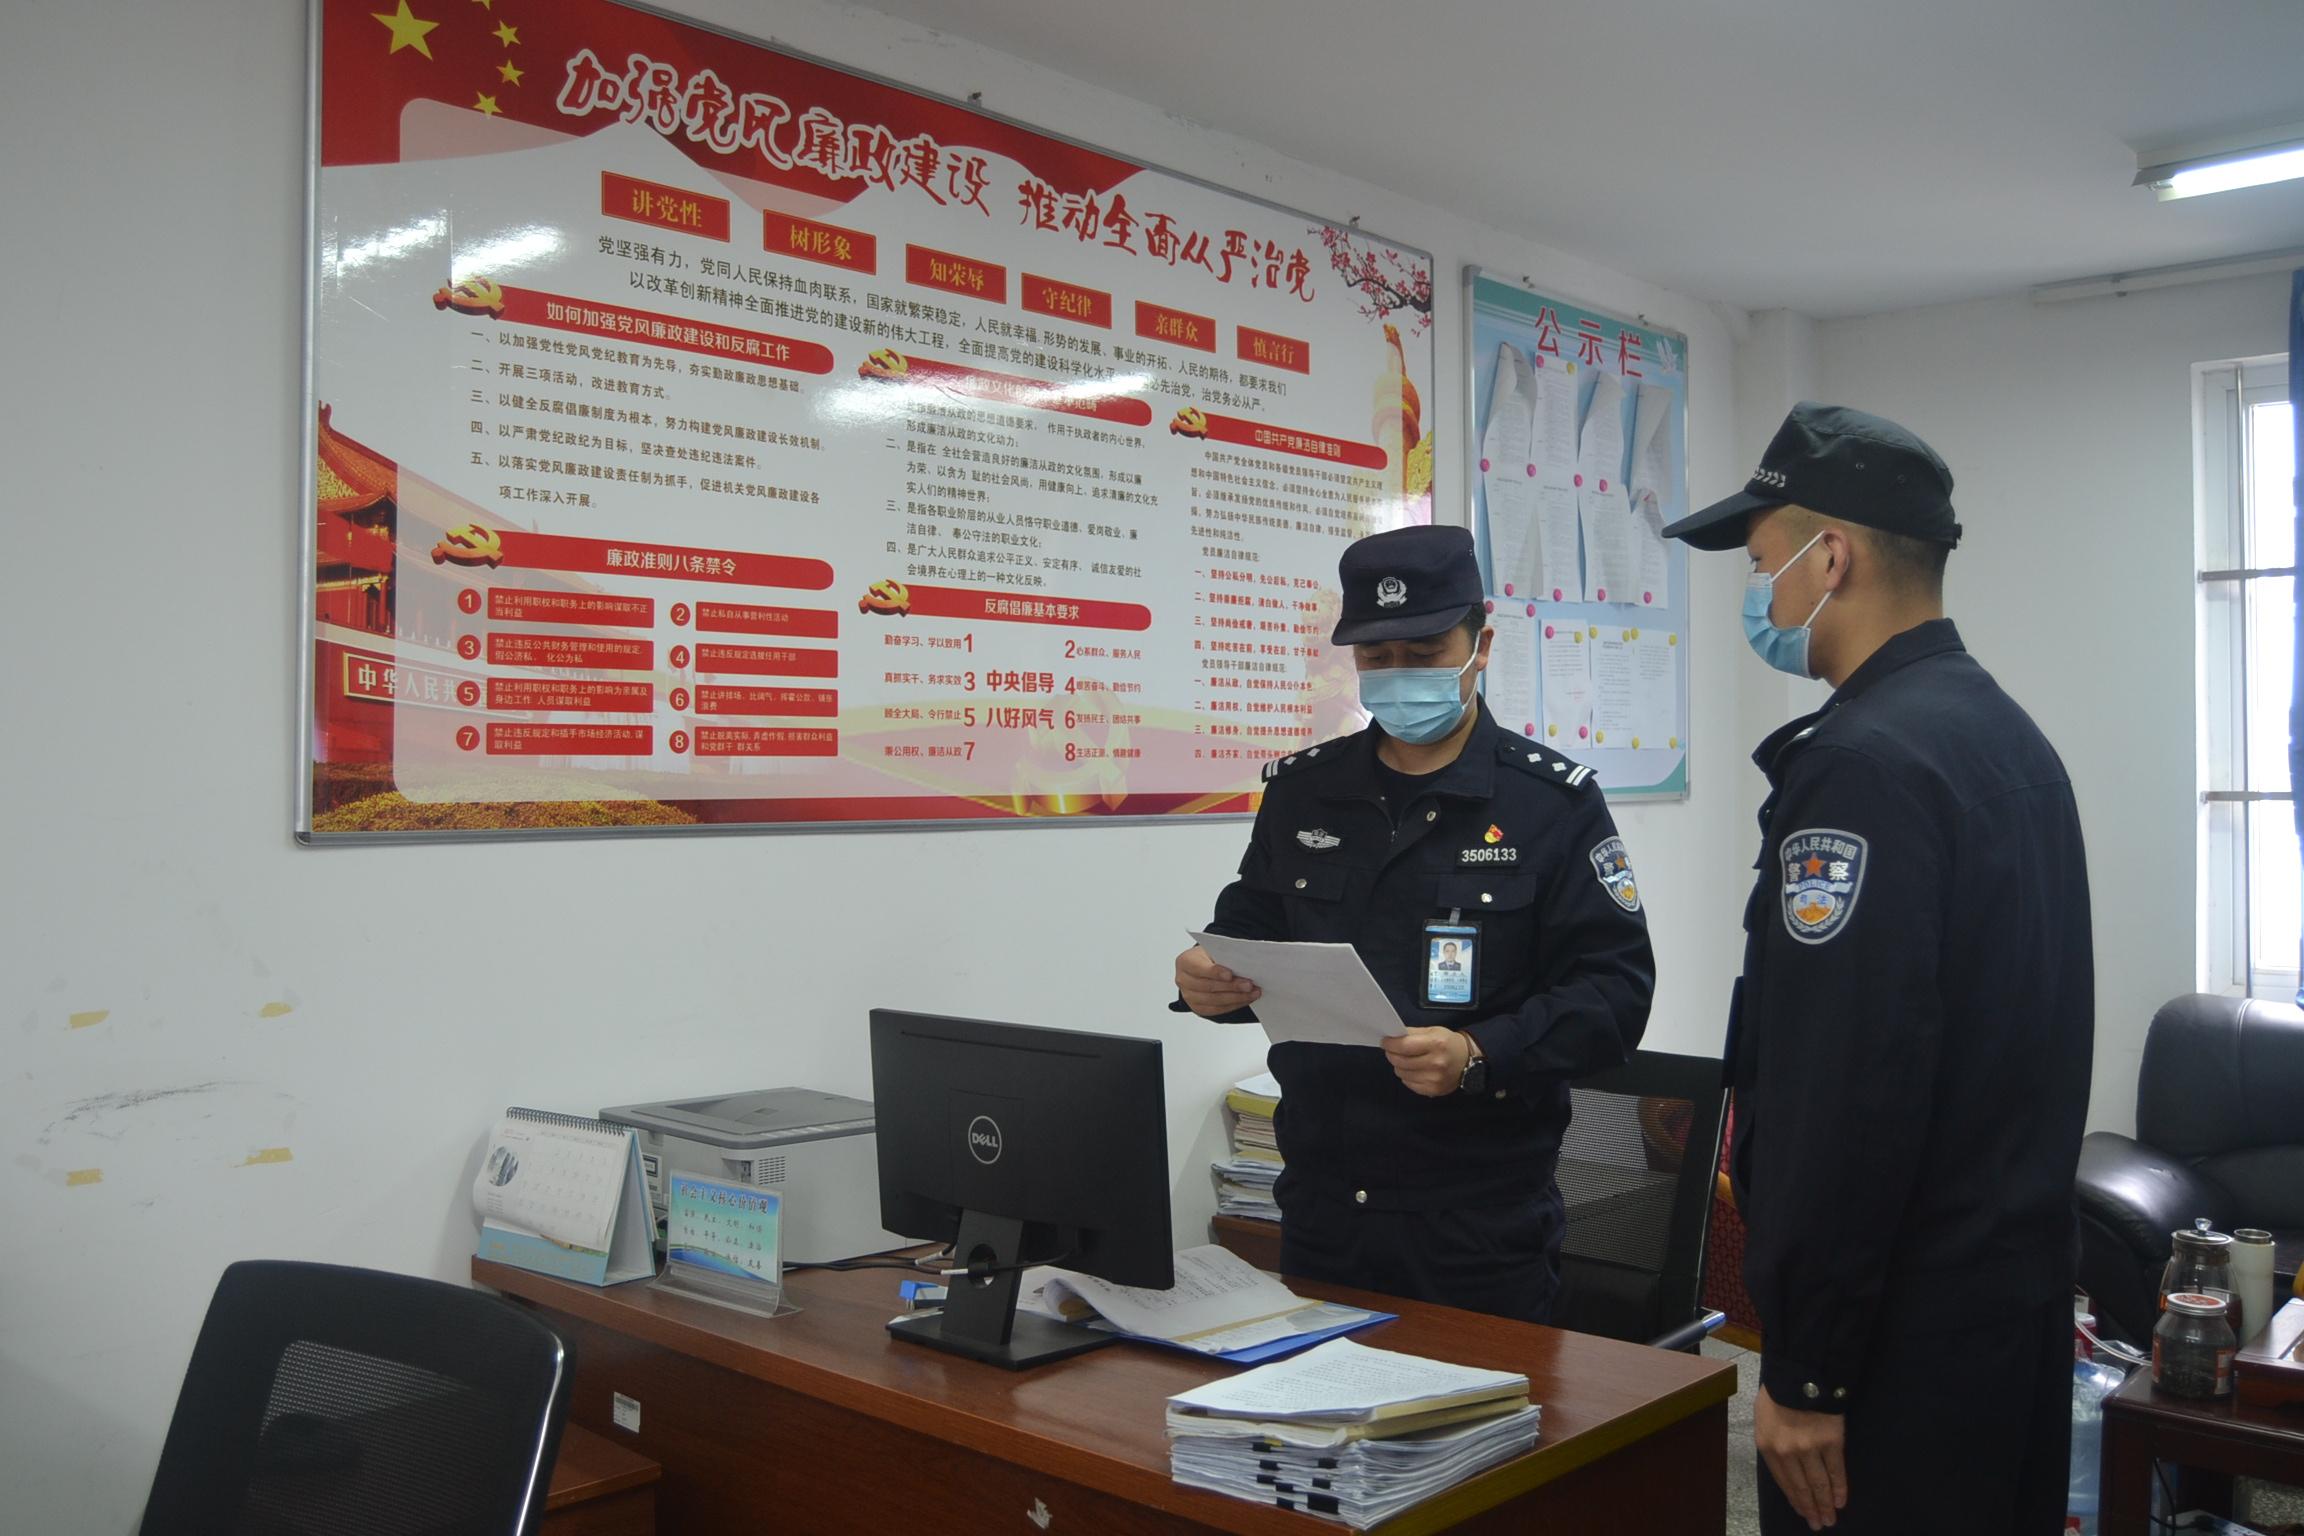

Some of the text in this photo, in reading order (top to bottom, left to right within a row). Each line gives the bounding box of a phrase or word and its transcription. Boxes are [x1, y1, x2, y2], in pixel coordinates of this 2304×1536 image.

[557, 49, 1316, 302] 加强党风廉政建设 推动全面从严治党
[632, 188, 703, 228] 讲党性
[790, 224, 852, 261] 树形象
[929, 256, 985, 292] 知荣辱
[1042, 286, 1093, 318] 守纪律
[546, 301, 790, 362] 如何加强党风廉政建设和反腐工作
[1155, 314, 1199, 343] 亲群众
[1253, 336, 1295, 365] 慎言行
[1535, 305, 1642, 378] 公示栏
[471, 359, 670, 400] 二、开展三项活动，改进教育方式。
[499, 485, 598, 508] 项工作深入开展。
[606, 548, 737, 576] 廉政准则八条禁令
[984, 599, 1080, 620] 反腐倡廉基本要求
[963, 633, 973, 653] 1
[1065, 640, 1076, 659] 2
[964, 671, 976, 691] 3
[986, 669, 1055, 693] 中央倡导
[1065, 676, 1076, 695] 4
[963, 707, 976, 727] 5
[986, 707, 1055, 730] 八好风气
[1065, 710, 1076, 729] 6
[963, 741, 976, 761] 7
[1065, 743, 1076, 761] 8
[1461, 848, 1518, 863] 3506133
[1785, 836, 1858, 861] 中华人民共和国
[971, 1132, 998, 1148] DELL
